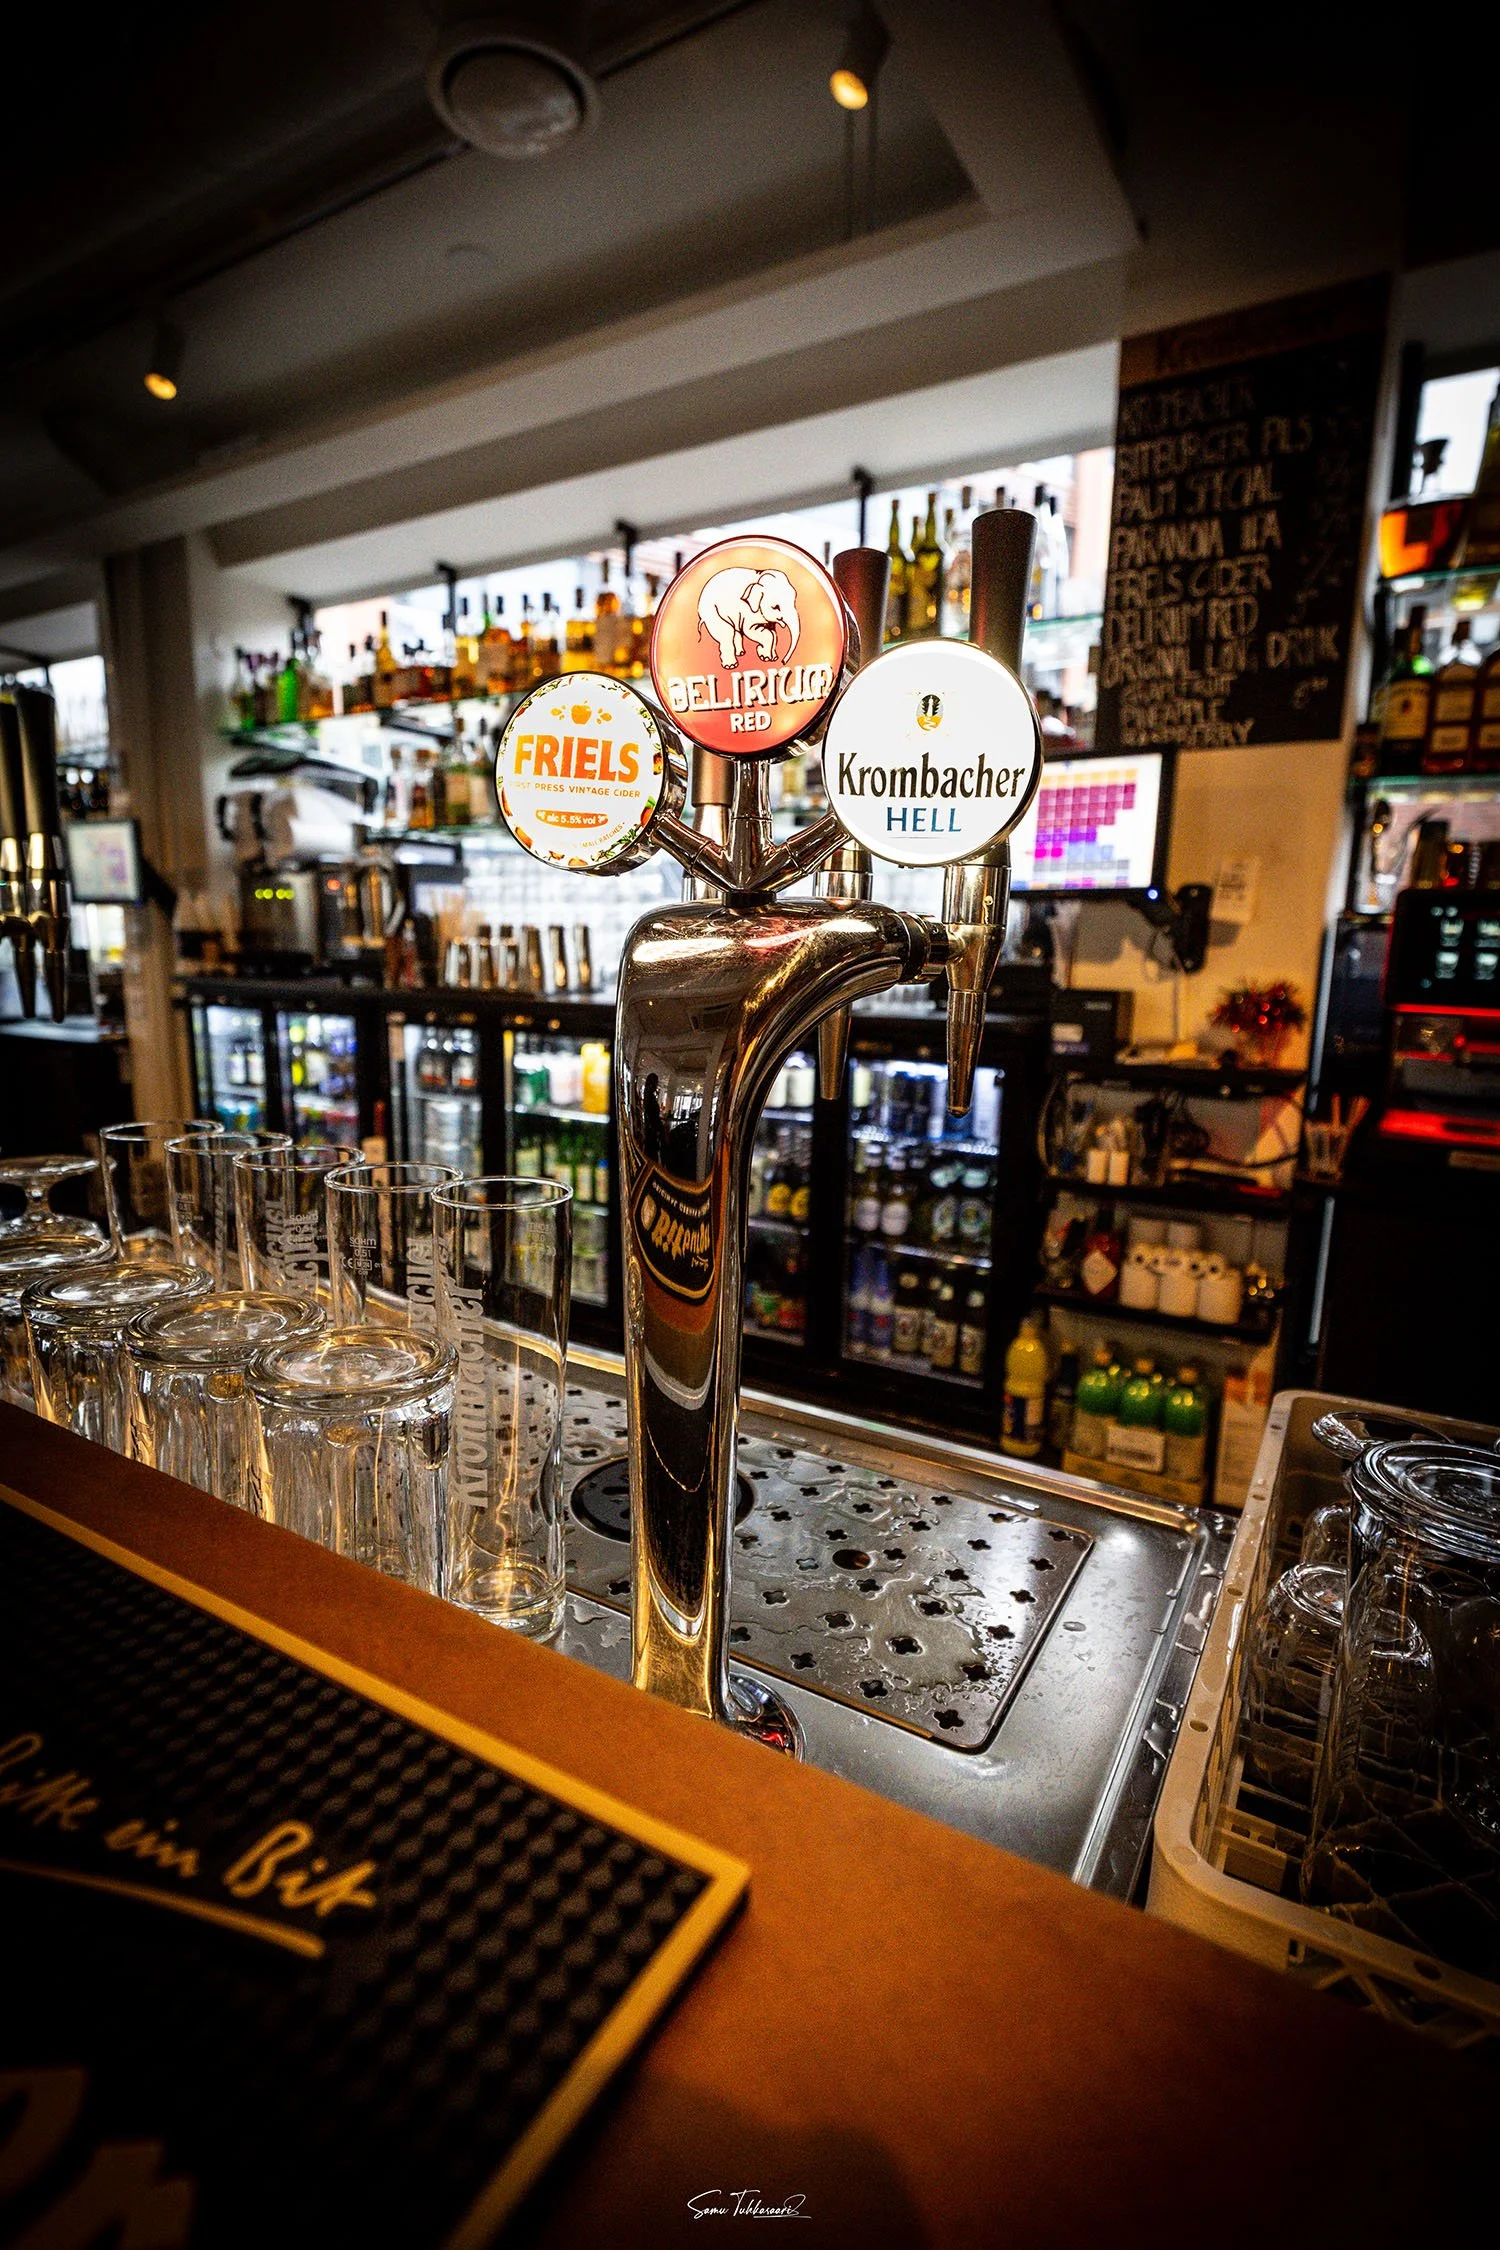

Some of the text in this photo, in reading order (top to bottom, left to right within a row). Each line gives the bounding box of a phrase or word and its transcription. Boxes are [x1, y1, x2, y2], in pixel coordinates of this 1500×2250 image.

[667, 663, 833, 714] DELIRIUM
[730, 711, 771, 734] RED
[513, 733, 640, 784] FRIELS
[837, 750, 1026, 800] Krombacher
[534, 781, 565, 793] PRESS
[568, 785, 611, 797] VINTAGE
[613, 788, 641, 799] CIDER
[582, 816, 596, 826] vol
[886, 806, 962, 834] HELL
[219, 1818, 378, 1919] Bit
